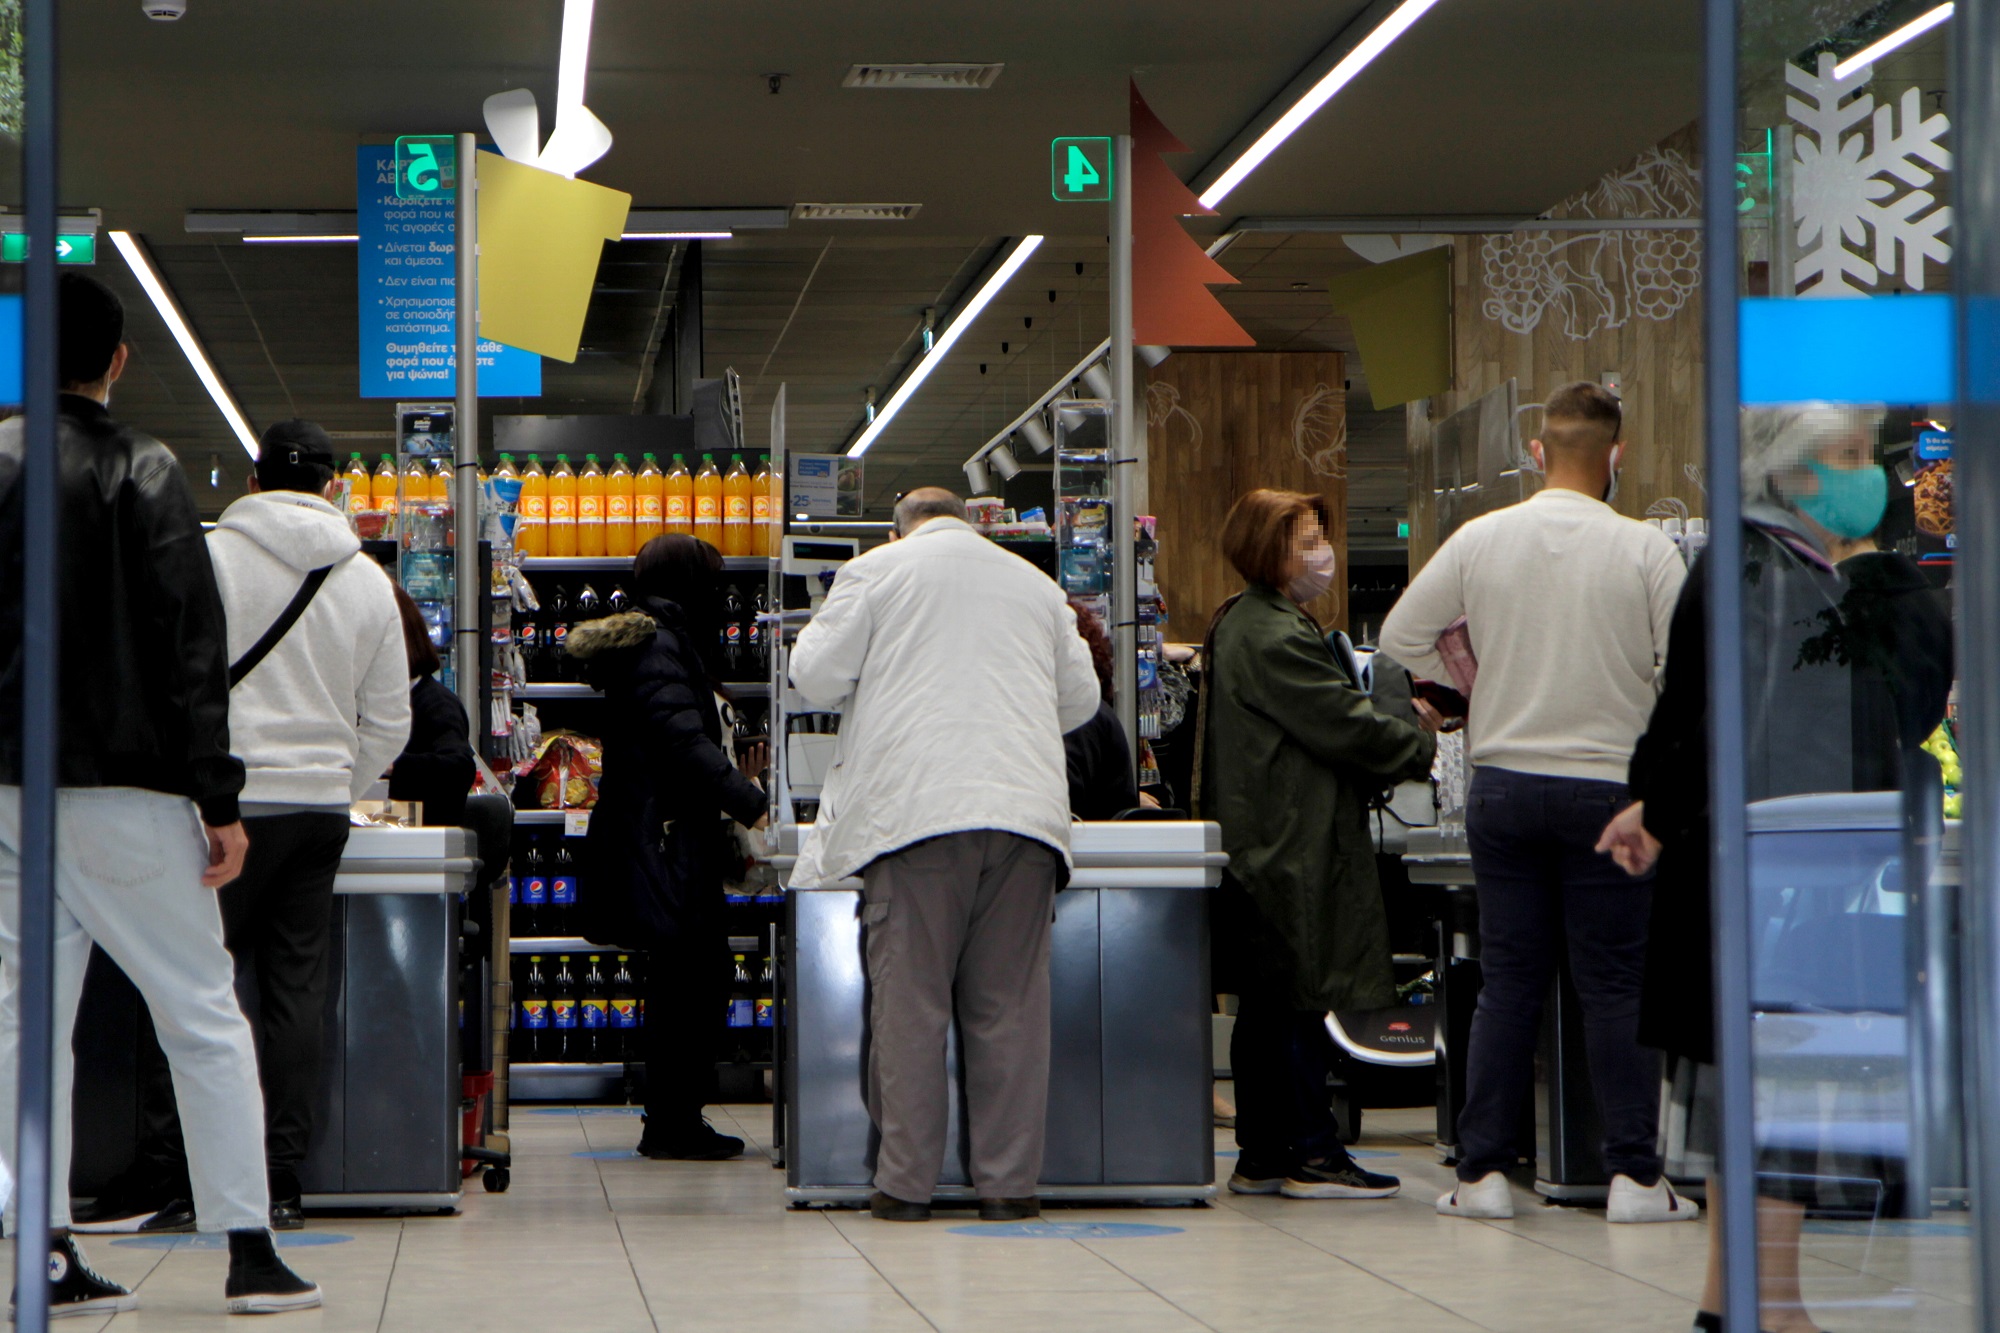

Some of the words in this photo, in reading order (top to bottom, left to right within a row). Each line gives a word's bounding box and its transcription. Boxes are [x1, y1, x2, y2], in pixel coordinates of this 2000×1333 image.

[384, 195, 442, 207] Κερδίζετε
[384, 209, 416, 220] φορά
[420, 211, 441, 219] που
[384, 224, 399, 233] τις
[402, 223, 444, 234] αγορές
[385, 242, 426, 252] Δίνεται
[428, 241, 455, 254] δωρ
[385, 257, 402, 265] και
[405, 255, 444, 266] άμεσα.
[385, 276, 408, 286] Δεν
[411, 275, 437, 286] είναι
[385, 311, 400, 319] σε
[385, 322, 450, 334] κατάστημα.
[386, 342, 448, 355] Θυμηθείτε
[386, 356, 418, 368] φορά
[422, 357, 444, 366] που
[386, 370, 405, 381] για
[408, 369, 449, 381] ψώνια!
